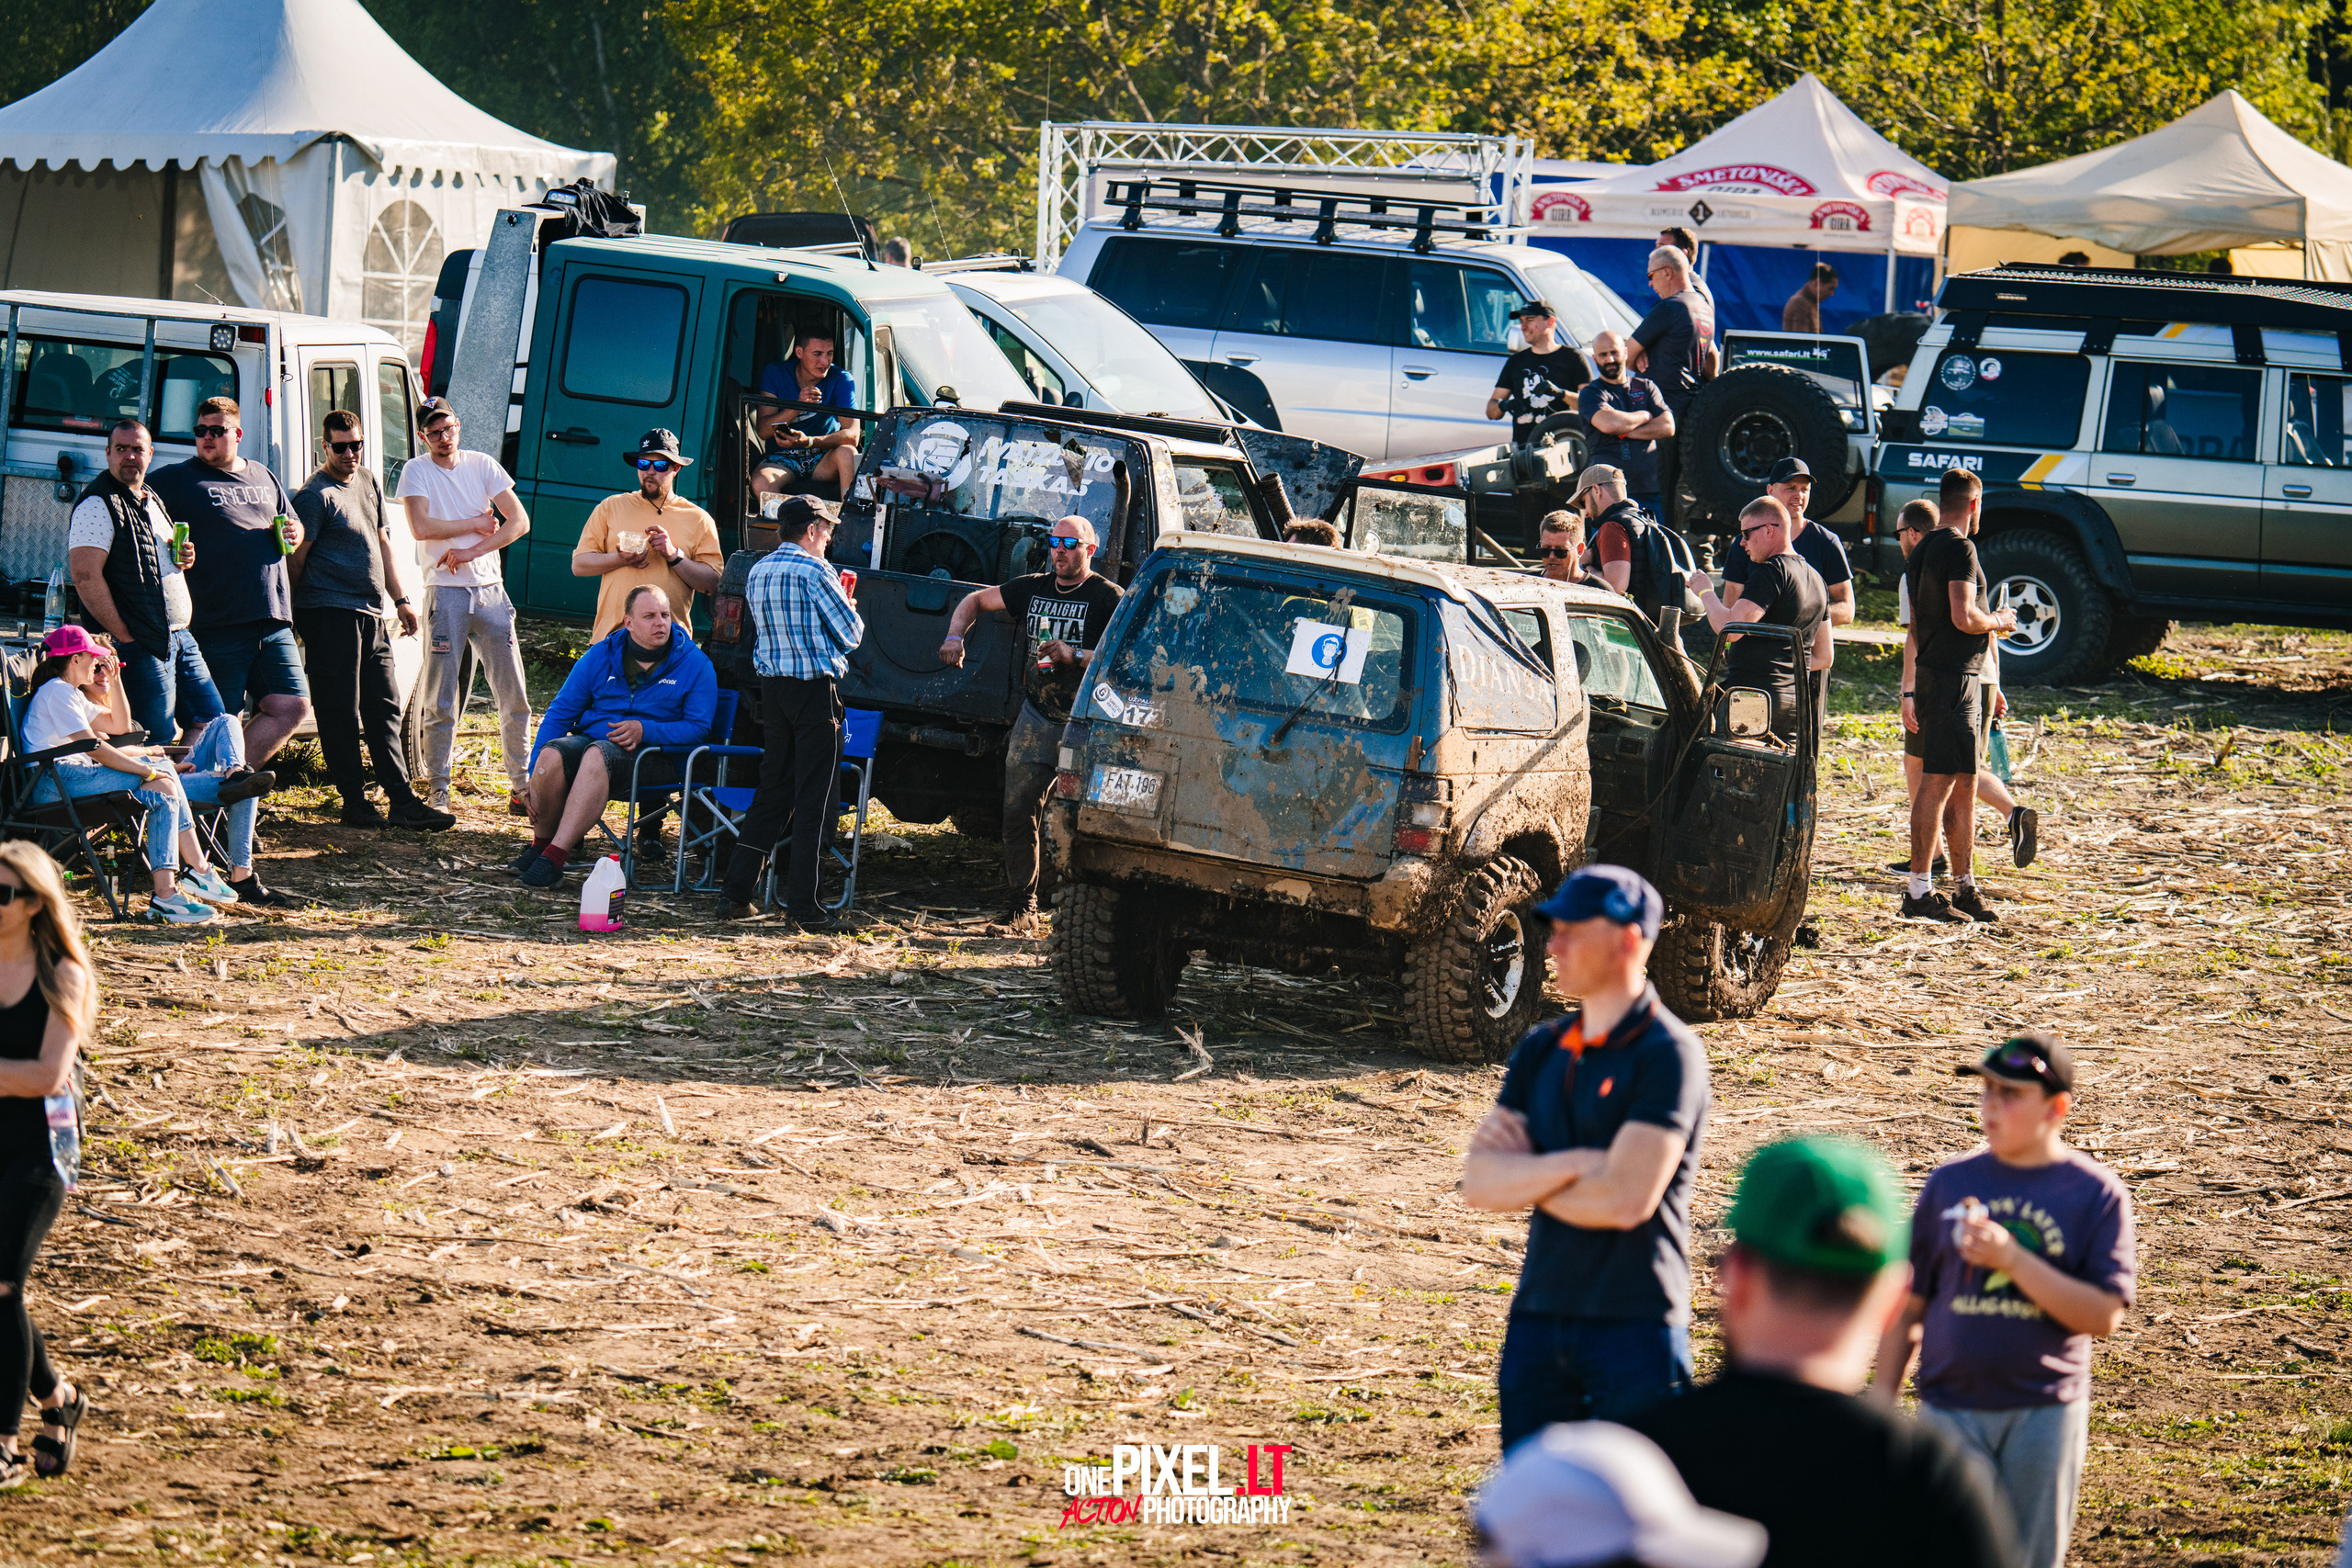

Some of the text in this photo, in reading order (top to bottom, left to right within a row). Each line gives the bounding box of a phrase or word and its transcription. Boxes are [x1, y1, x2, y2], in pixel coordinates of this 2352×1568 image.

[1747, 349, 1810, 358] www.safari.lt
[1908, 452, 1984, 471] SAFARI
[208, 486, 275, 506] SNOOZE
[1031, 599, 1086, 618] STRAIGHT
[1106, 772, 1133, 791] FAT
